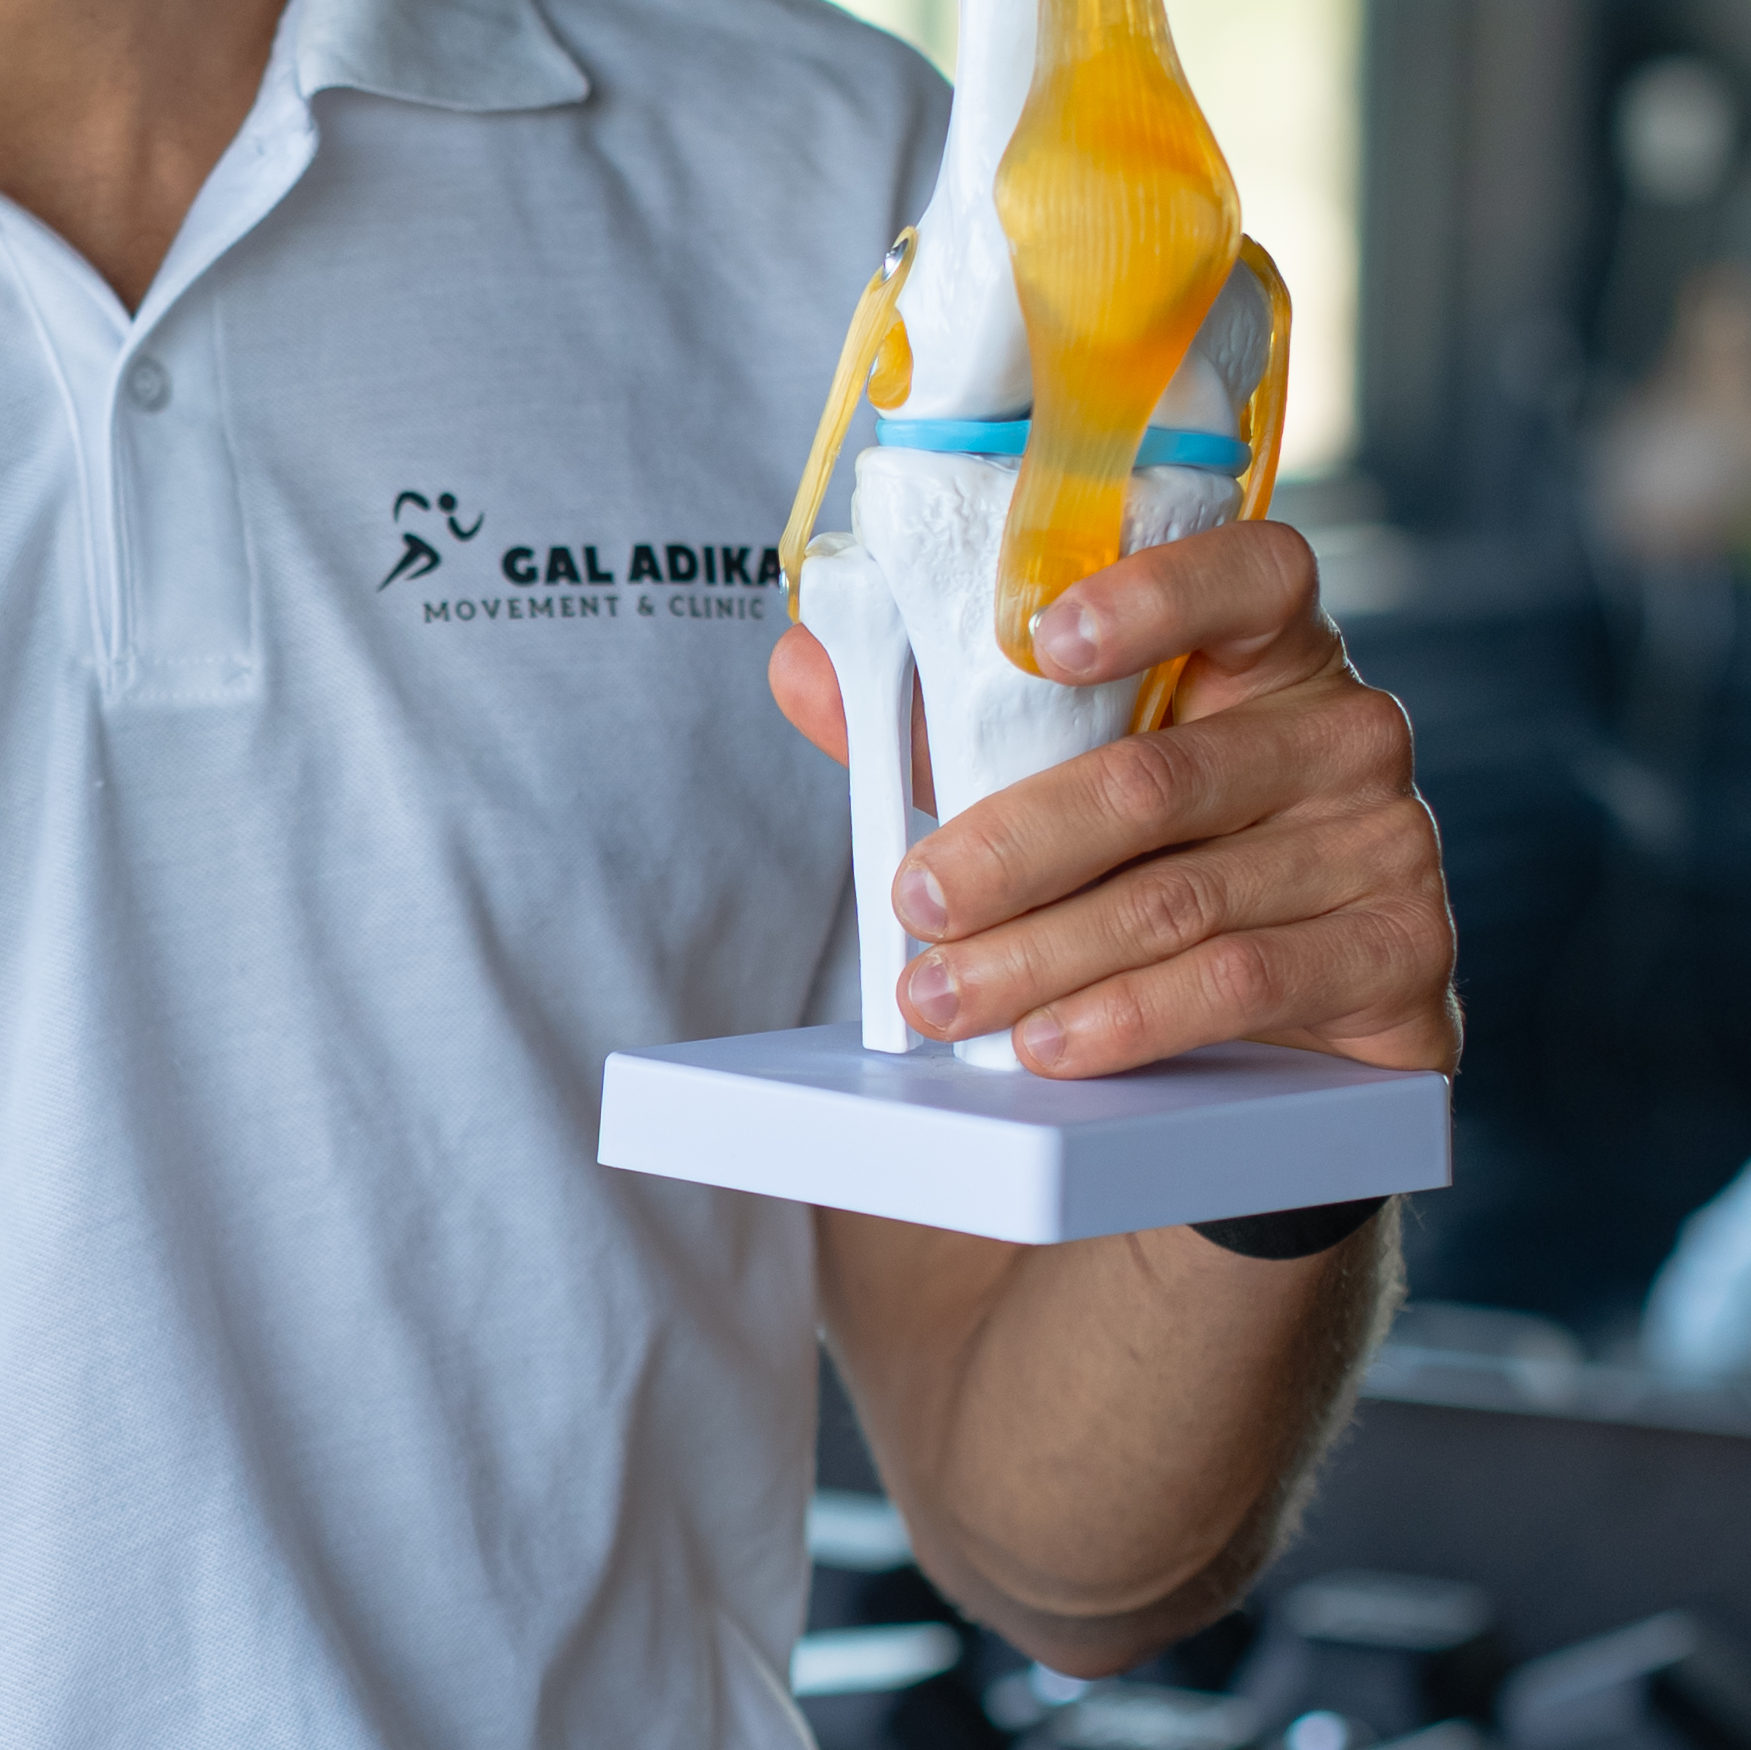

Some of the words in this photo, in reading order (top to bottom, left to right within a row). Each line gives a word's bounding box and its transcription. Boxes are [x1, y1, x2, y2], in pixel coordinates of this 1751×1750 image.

[502, 546, 613, 585] GAL
[629, 544, 780, 586] ADIKA
[424, 596, 619, 623] MOVEMENT
[638, 596, 655, 617] &
[668, 596, 765, 620] CLINIC
